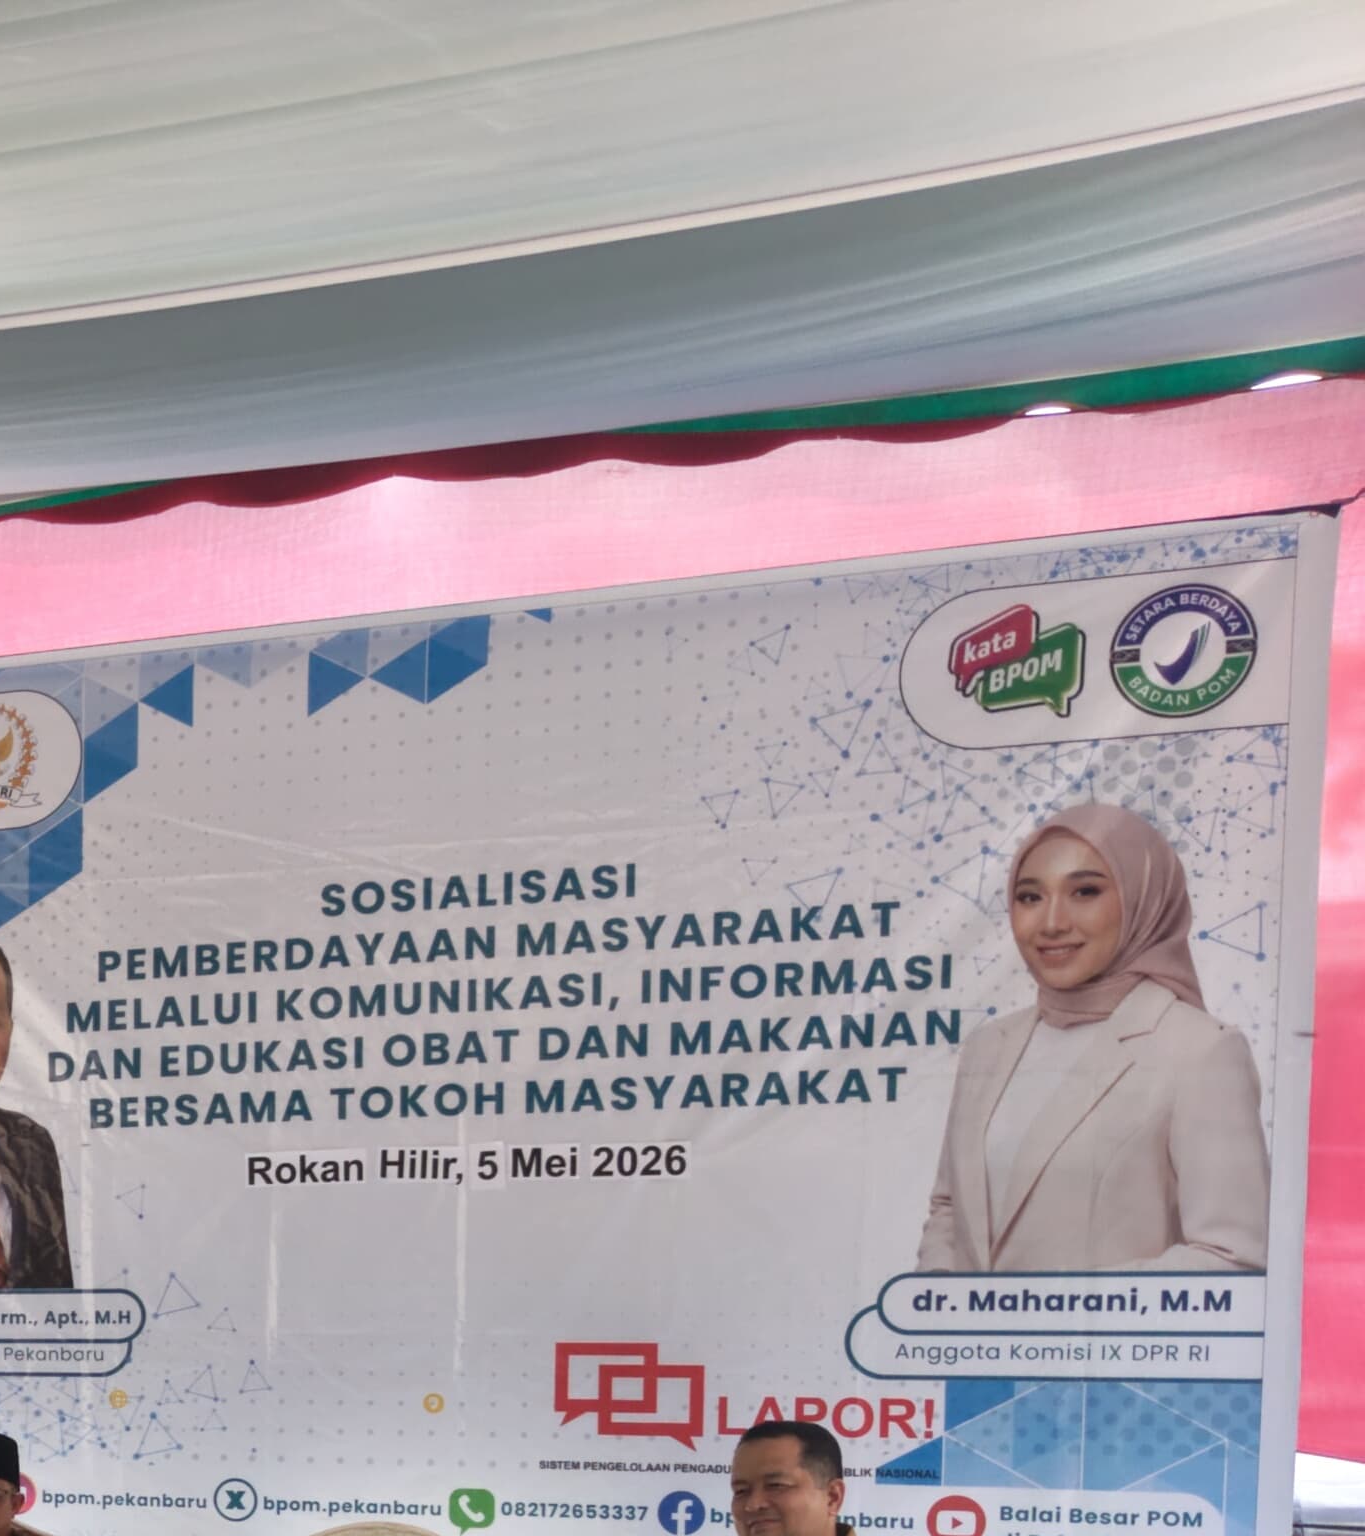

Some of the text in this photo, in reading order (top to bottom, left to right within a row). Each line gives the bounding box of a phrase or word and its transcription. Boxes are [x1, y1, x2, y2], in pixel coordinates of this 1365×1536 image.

[1125, 592, 1242, 642] SETARA BERDAYA
[963, 630, 1017, 665] kata
[988, 648, 1063, 693] BPOM
[1128, 668, 1237, 706] BADAN POM
[320, 863, 636, 917] SOSIALISASI
[97, 901, 901, 982] PEMBERDAYAAN MASYARAKAT
[66, 953, 953, 1033] MELALUI KOMUNIKASI, INFORMASI
[47, 1009, 961, 1083] DAN EDUKASI OBAT DAN MAKANAN
[89, 1066, 908, 1129] BERSAMA TOKOH MASYARAKAT
[247, 1145, 688, 1186] Rokan Hilir, 5 Mei 2026
[912, 1288, 1233, 1315] dr. Maharani, M.M
[44, 1310, 90, 1330] Apt.,
[94, 1311, 132, 1325] M.H
[4, 1346, 105, 1361] Pekanbaru
[894, 1343, 1211, 1365] Anggota Komisi IX DPR RI
[717, 1395, 936, 1439] LAPOR!
[538, 1460, 941, 1480] SISTEM PENGELOLAAN PENGADU BLIK NASIONAL
[41, 1489, 208, 1511] bpom.pekanbaru
[263, 1495, 442, 1518] bpom.pekanbaru
[500, 1500, 649, 1521] 082172653337
[999, 1505, 1204, 1528] Balai Besar POM
